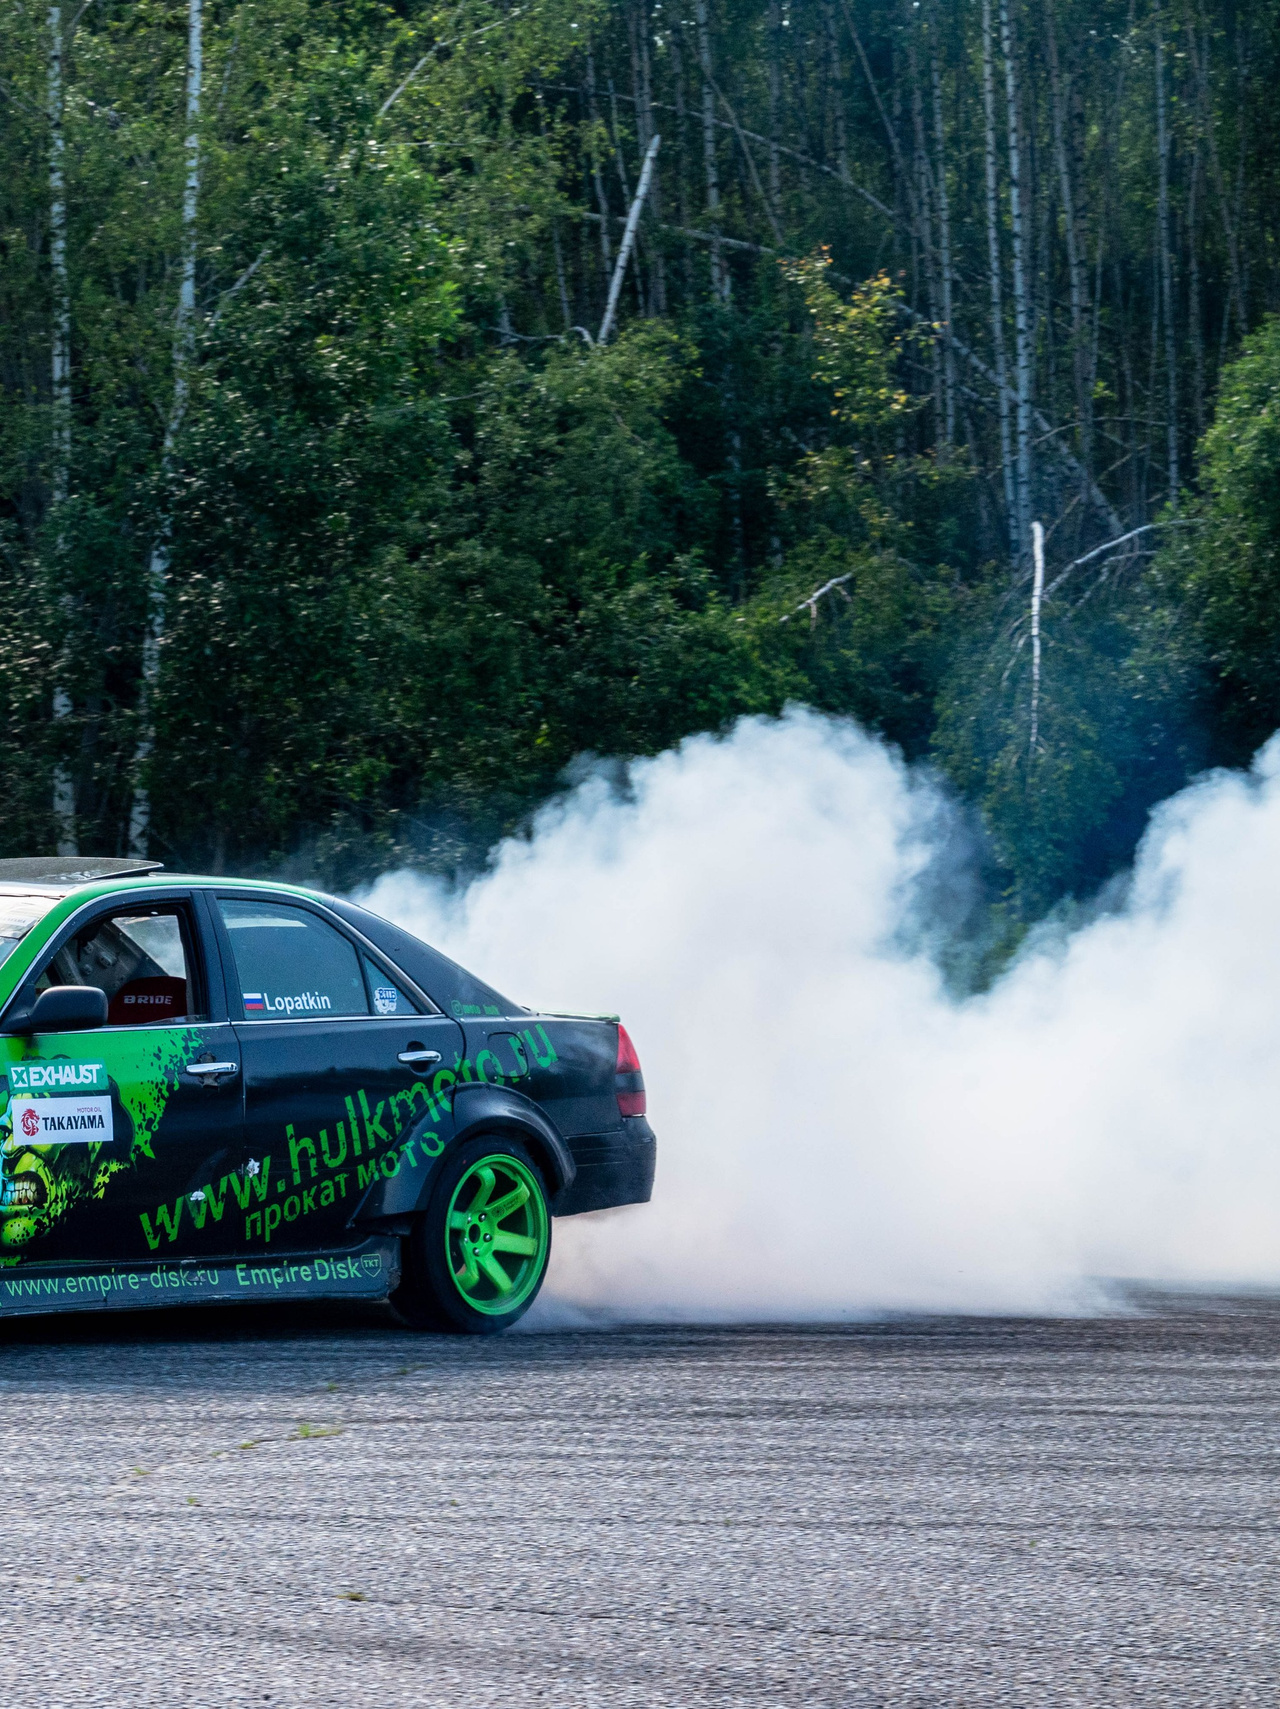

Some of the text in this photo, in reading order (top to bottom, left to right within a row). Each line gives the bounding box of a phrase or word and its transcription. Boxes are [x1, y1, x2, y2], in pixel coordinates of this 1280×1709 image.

[264, 991, 331, 1014] Lopatkin
[29, 1064, 100, 1086] EXHAUST
[42, 1115, 105, 1131] TAKAYAMA
[244, 1173, 350, 1242] прокат
[363, 1259, 379, 1267] TKT
[5, 1264, 219, 1297] www.empire-disk.ru
